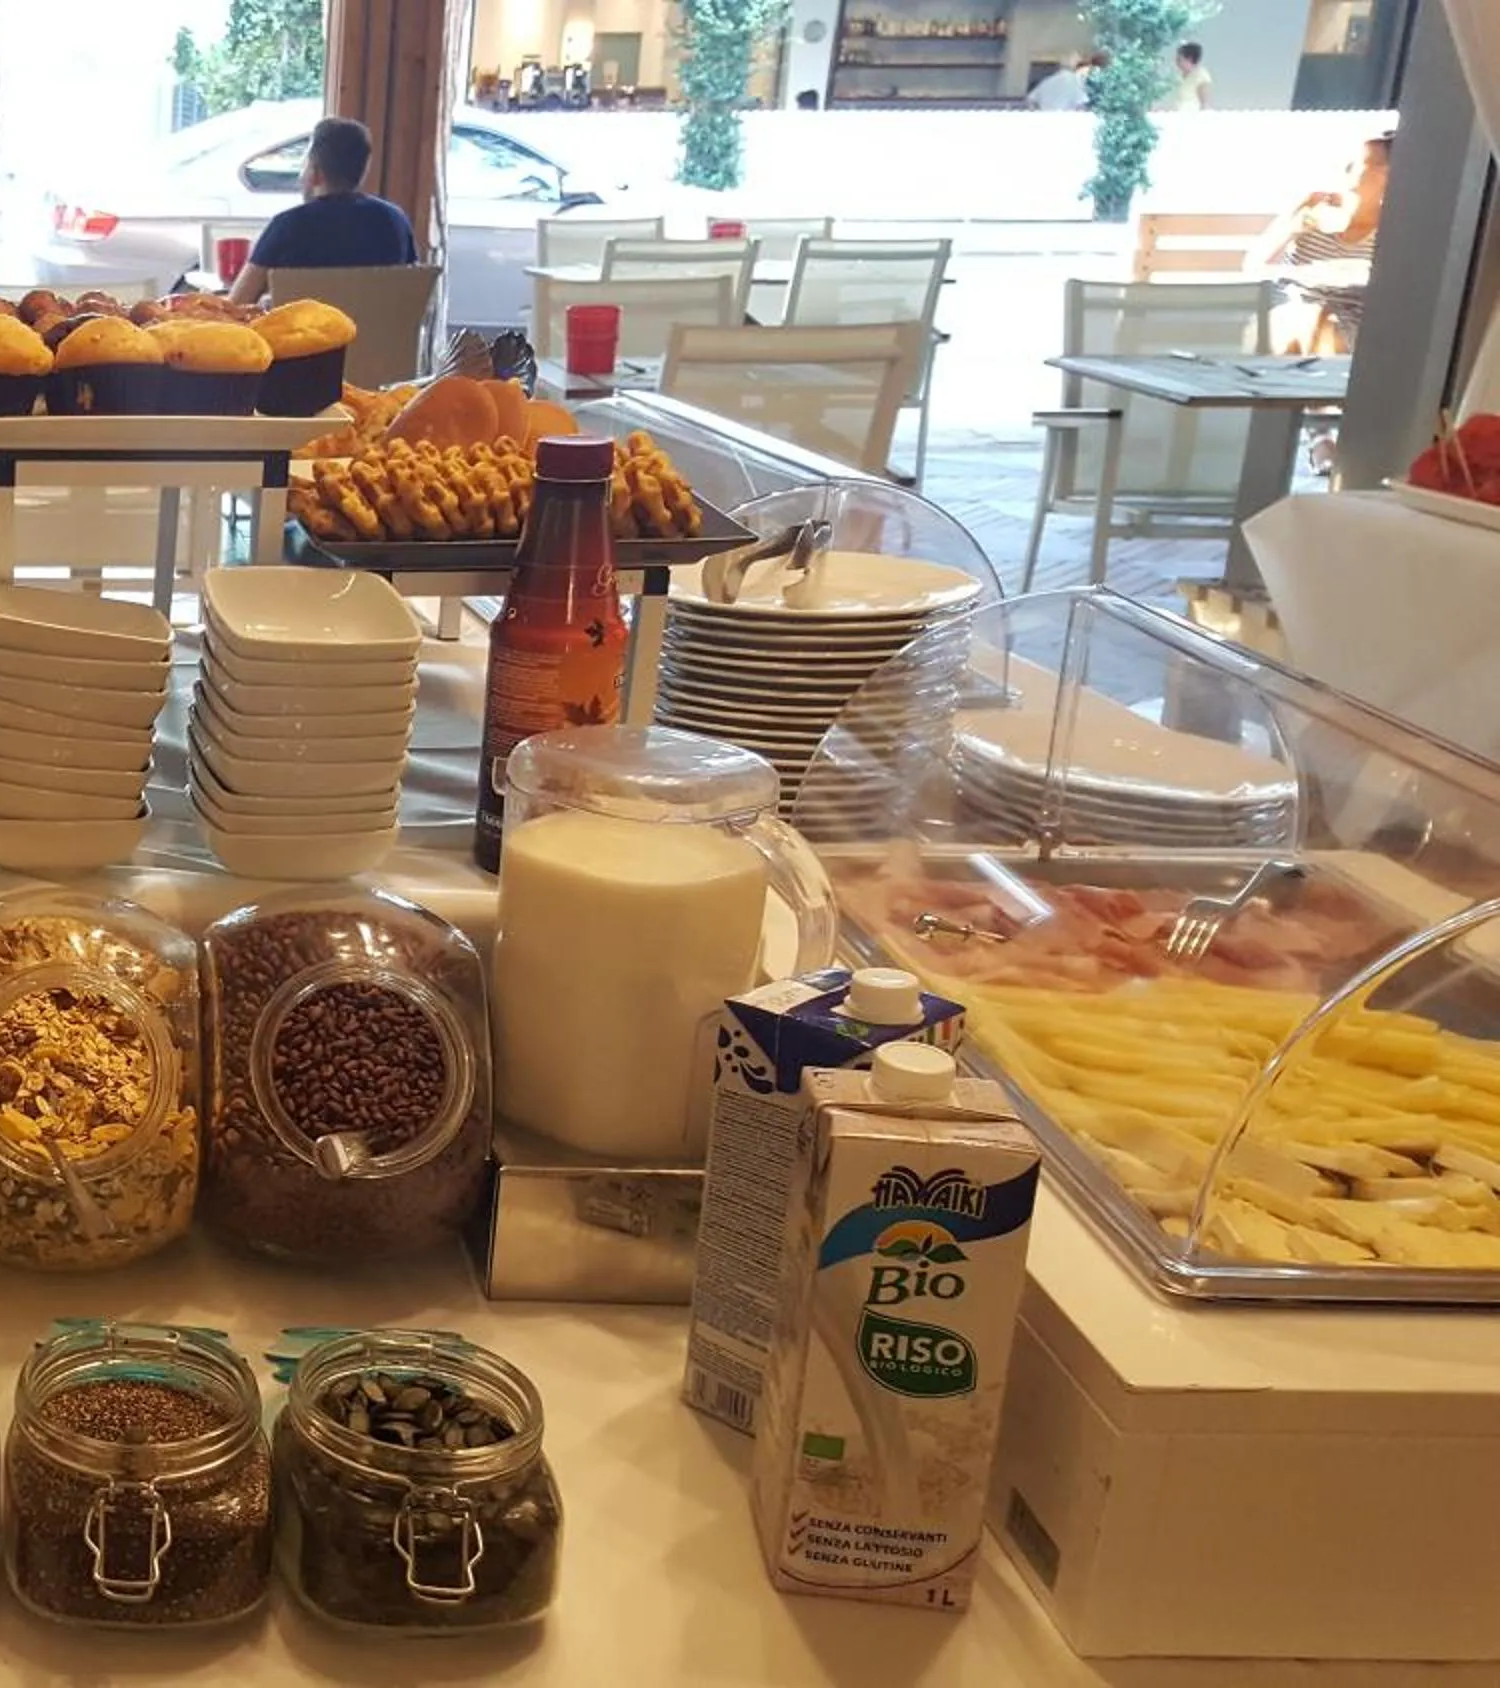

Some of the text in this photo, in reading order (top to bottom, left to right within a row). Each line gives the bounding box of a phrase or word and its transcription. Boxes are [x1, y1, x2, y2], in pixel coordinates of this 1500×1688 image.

[864, 1260, 965, 1305] Bio
[870, 1333, 967, 1366] RISO
[808, 1517, 851, 1534] SENZA
[806, 1533, 851, 1550] SENZA
[804, 1549, 849, 1566] SENZA
[926, 1588, 956, 1607] 1 L
